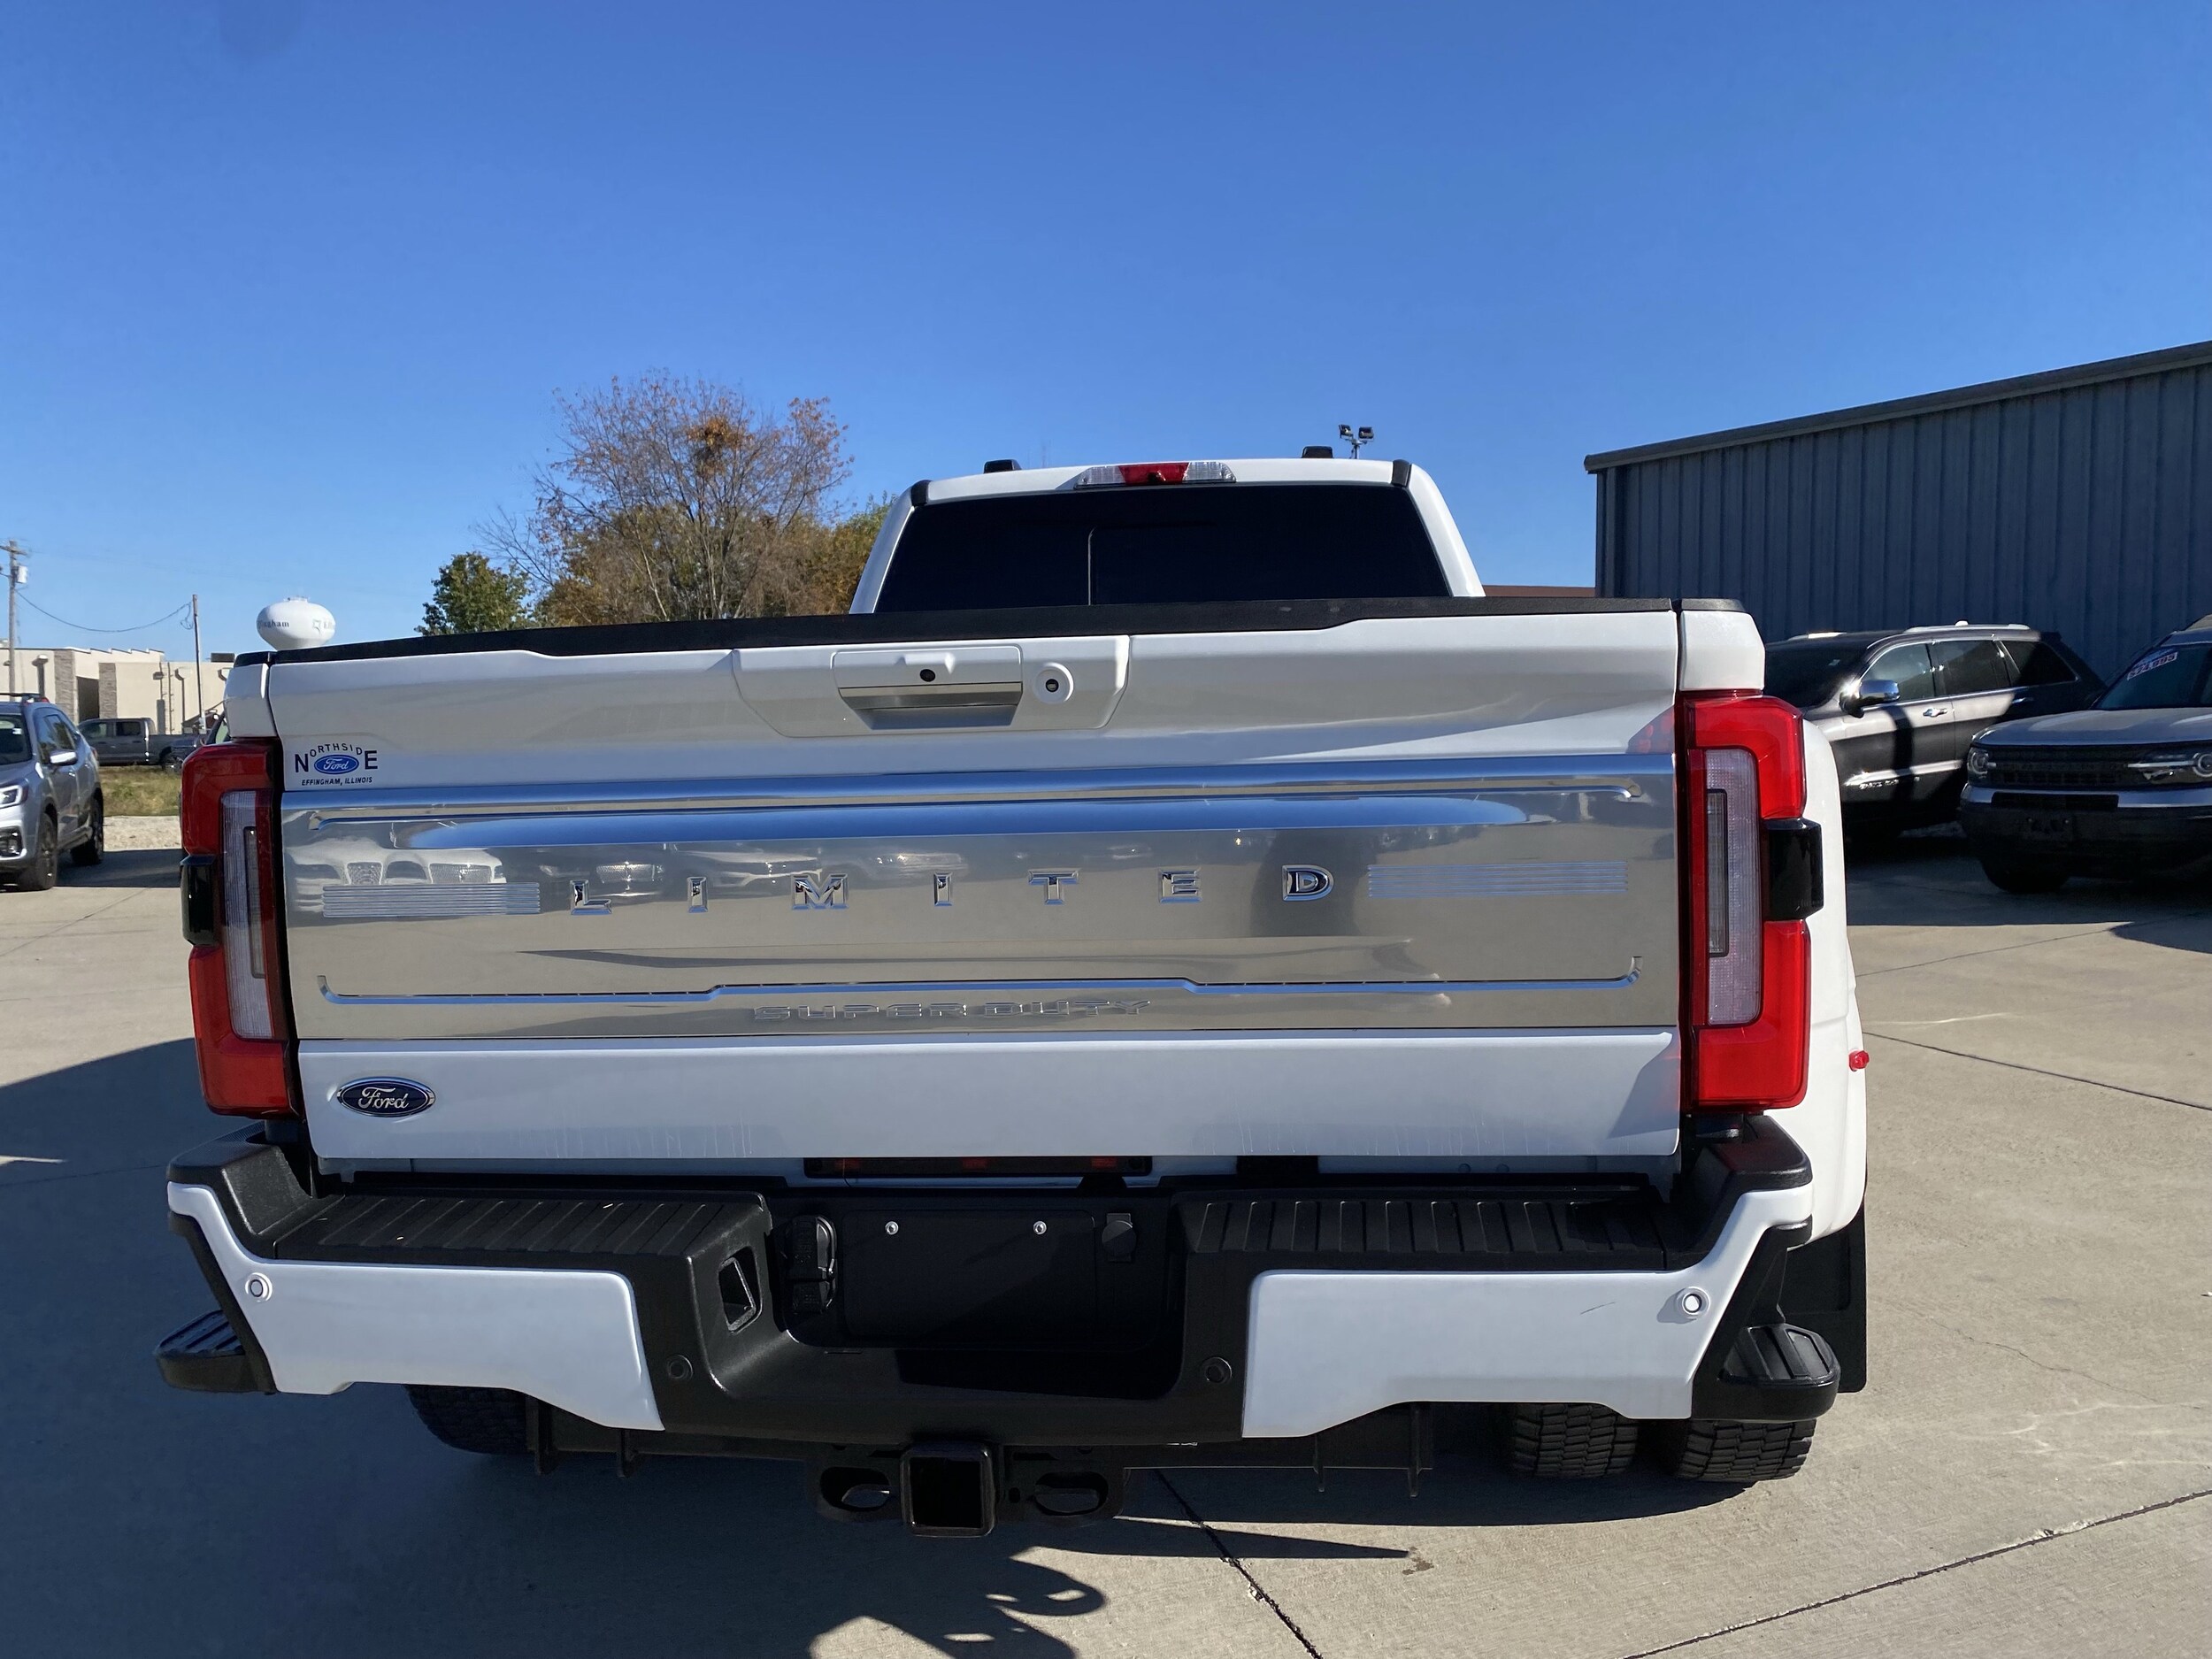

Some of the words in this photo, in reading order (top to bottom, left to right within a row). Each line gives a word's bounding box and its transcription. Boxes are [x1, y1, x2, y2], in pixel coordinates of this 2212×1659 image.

[295, 742, 378, 772] NORTHSIDE
[323, 757, 349, 770] Ford
[570, 864, 1334, 916] LIMITED
[754, 1002, 967, 1020] SUPER
[984, 1000, 1149, 1017] DUTY
[357, 1087, 410, 1109] Ford
